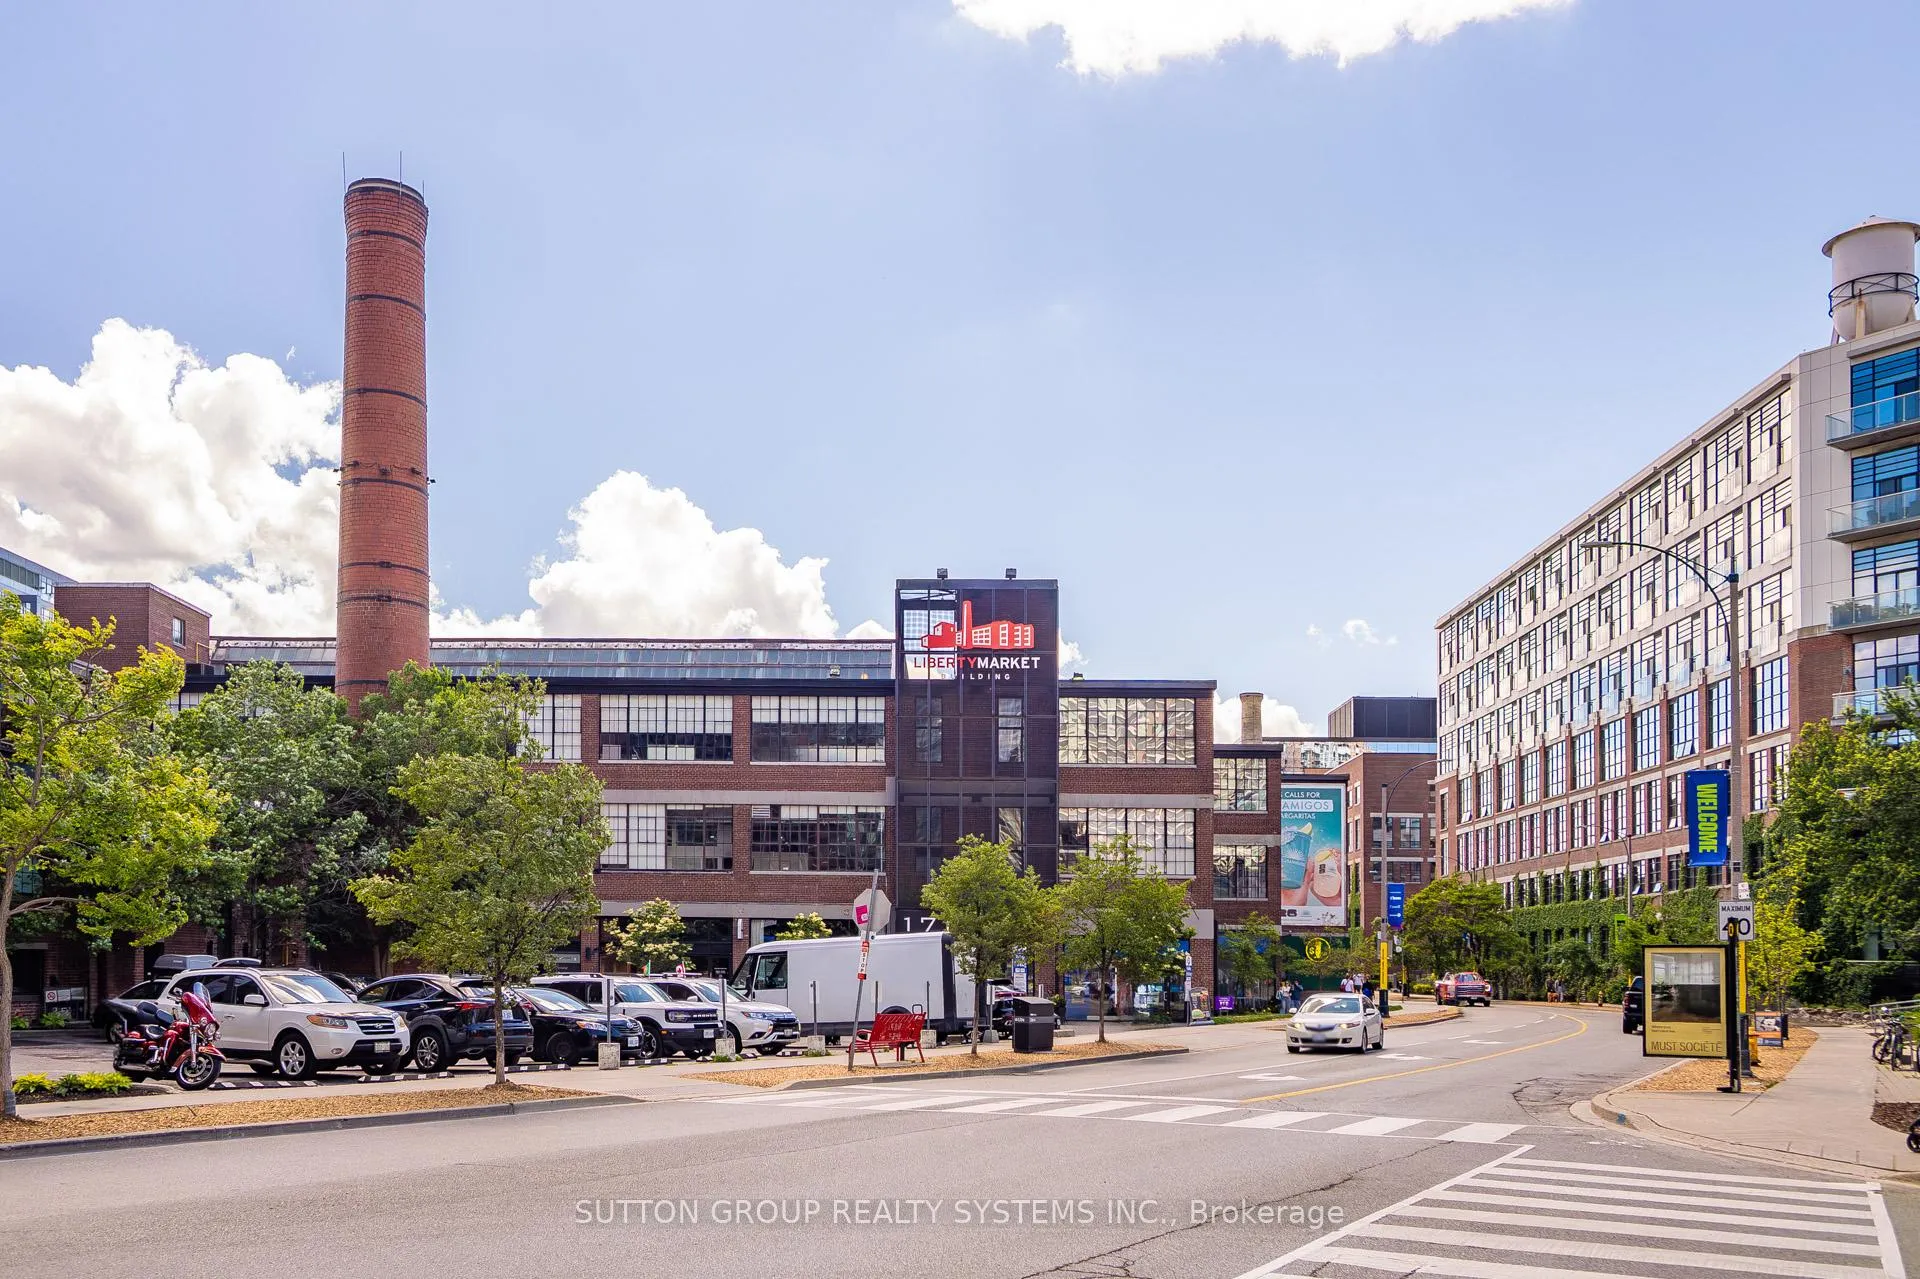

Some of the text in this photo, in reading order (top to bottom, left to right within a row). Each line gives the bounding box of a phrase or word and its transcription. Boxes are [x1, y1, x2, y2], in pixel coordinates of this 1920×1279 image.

[1282, 801, 1329, 810] AMIGOS
[1697, 783, 1718, 853] WELCOME
[1651, 1041, 1677, 1051] MUST
